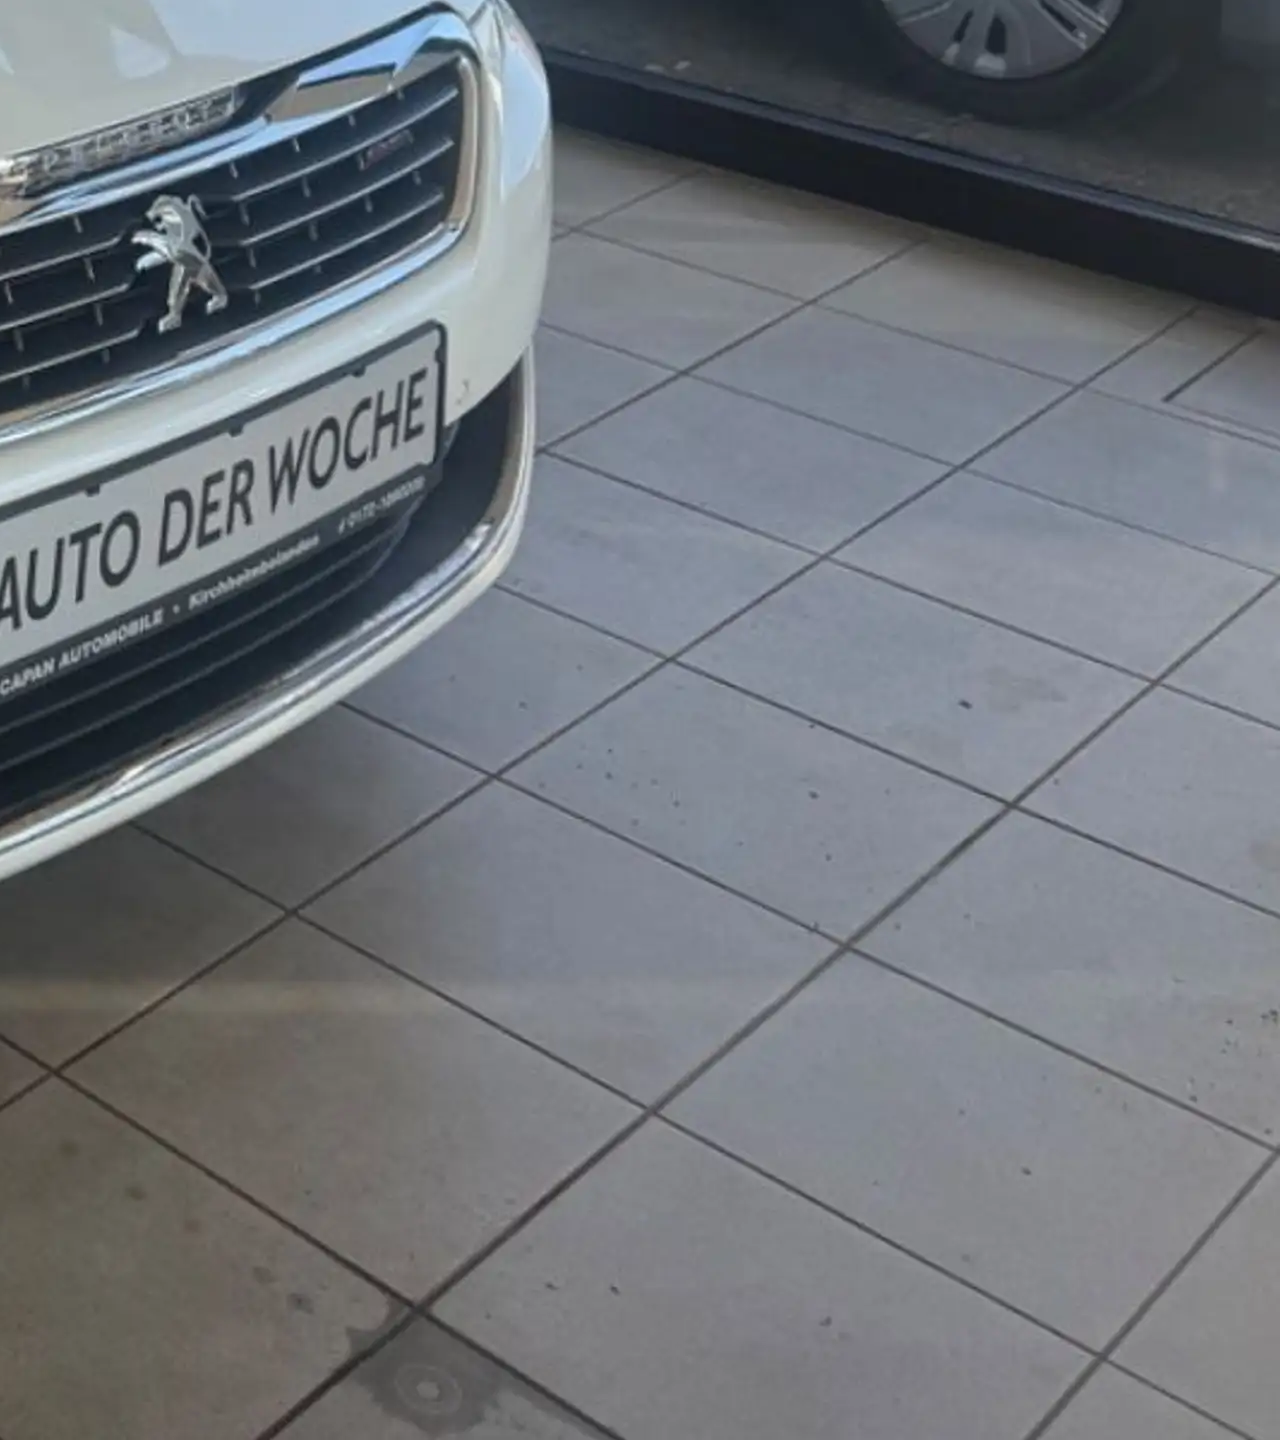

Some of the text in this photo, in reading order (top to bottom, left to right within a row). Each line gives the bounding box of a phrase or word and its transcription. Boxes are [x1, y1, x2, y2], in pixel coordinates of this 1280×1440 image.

[158, 459, 254, 567] DER
[268, 368, 428, 513] WOCHE
[58, 610, 164, 672] AUTOMOBILE
